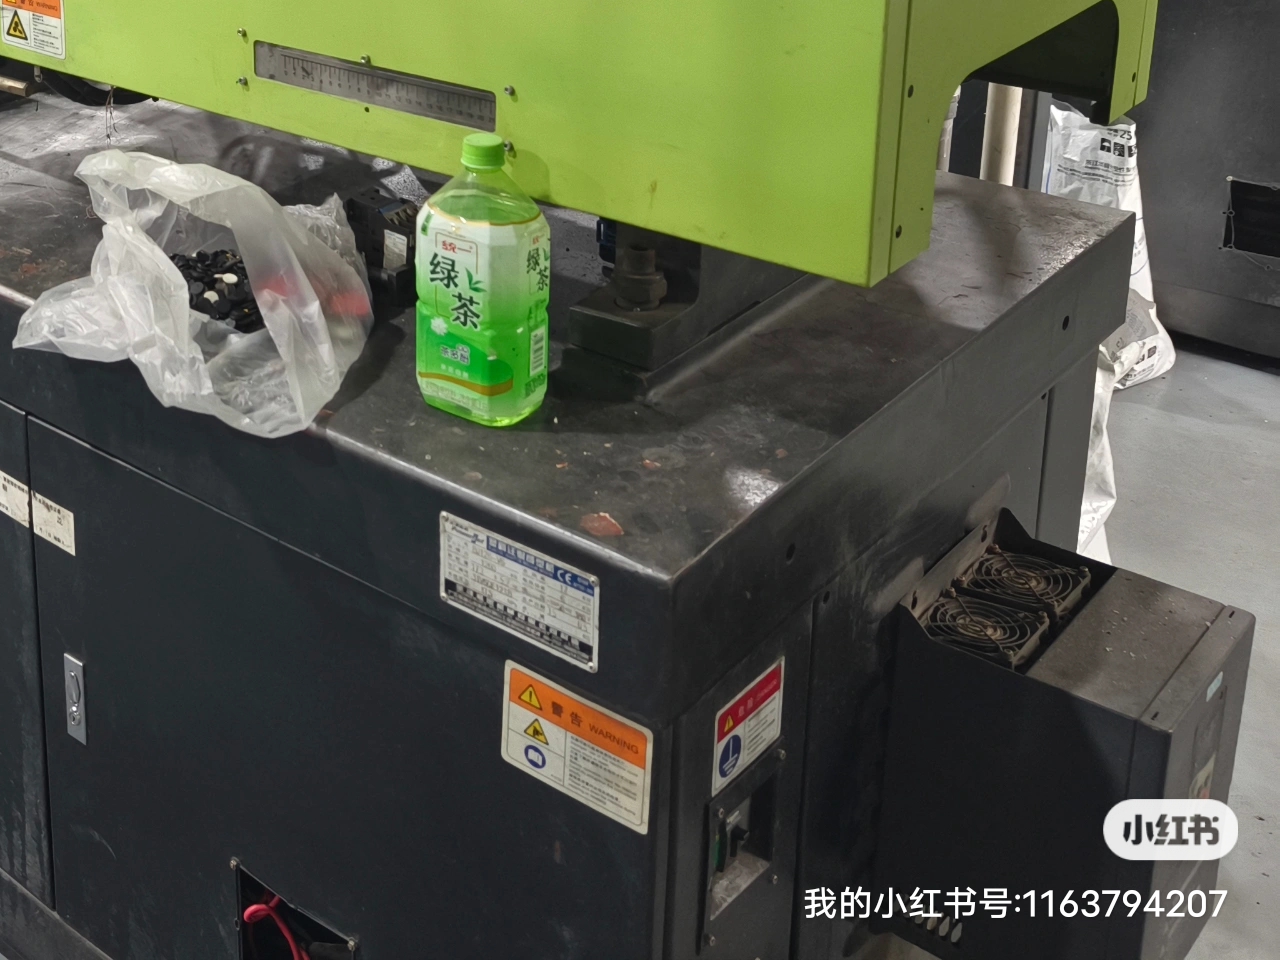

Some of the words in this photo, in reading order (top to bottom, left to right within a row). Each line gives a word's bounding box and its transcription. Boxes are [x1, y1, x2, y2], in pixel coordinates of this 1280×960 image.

[429, 252, 481, 330] 绿茶
[551, 700, 584, 728] 警告
[588, 723, 640, 755] WARNING
